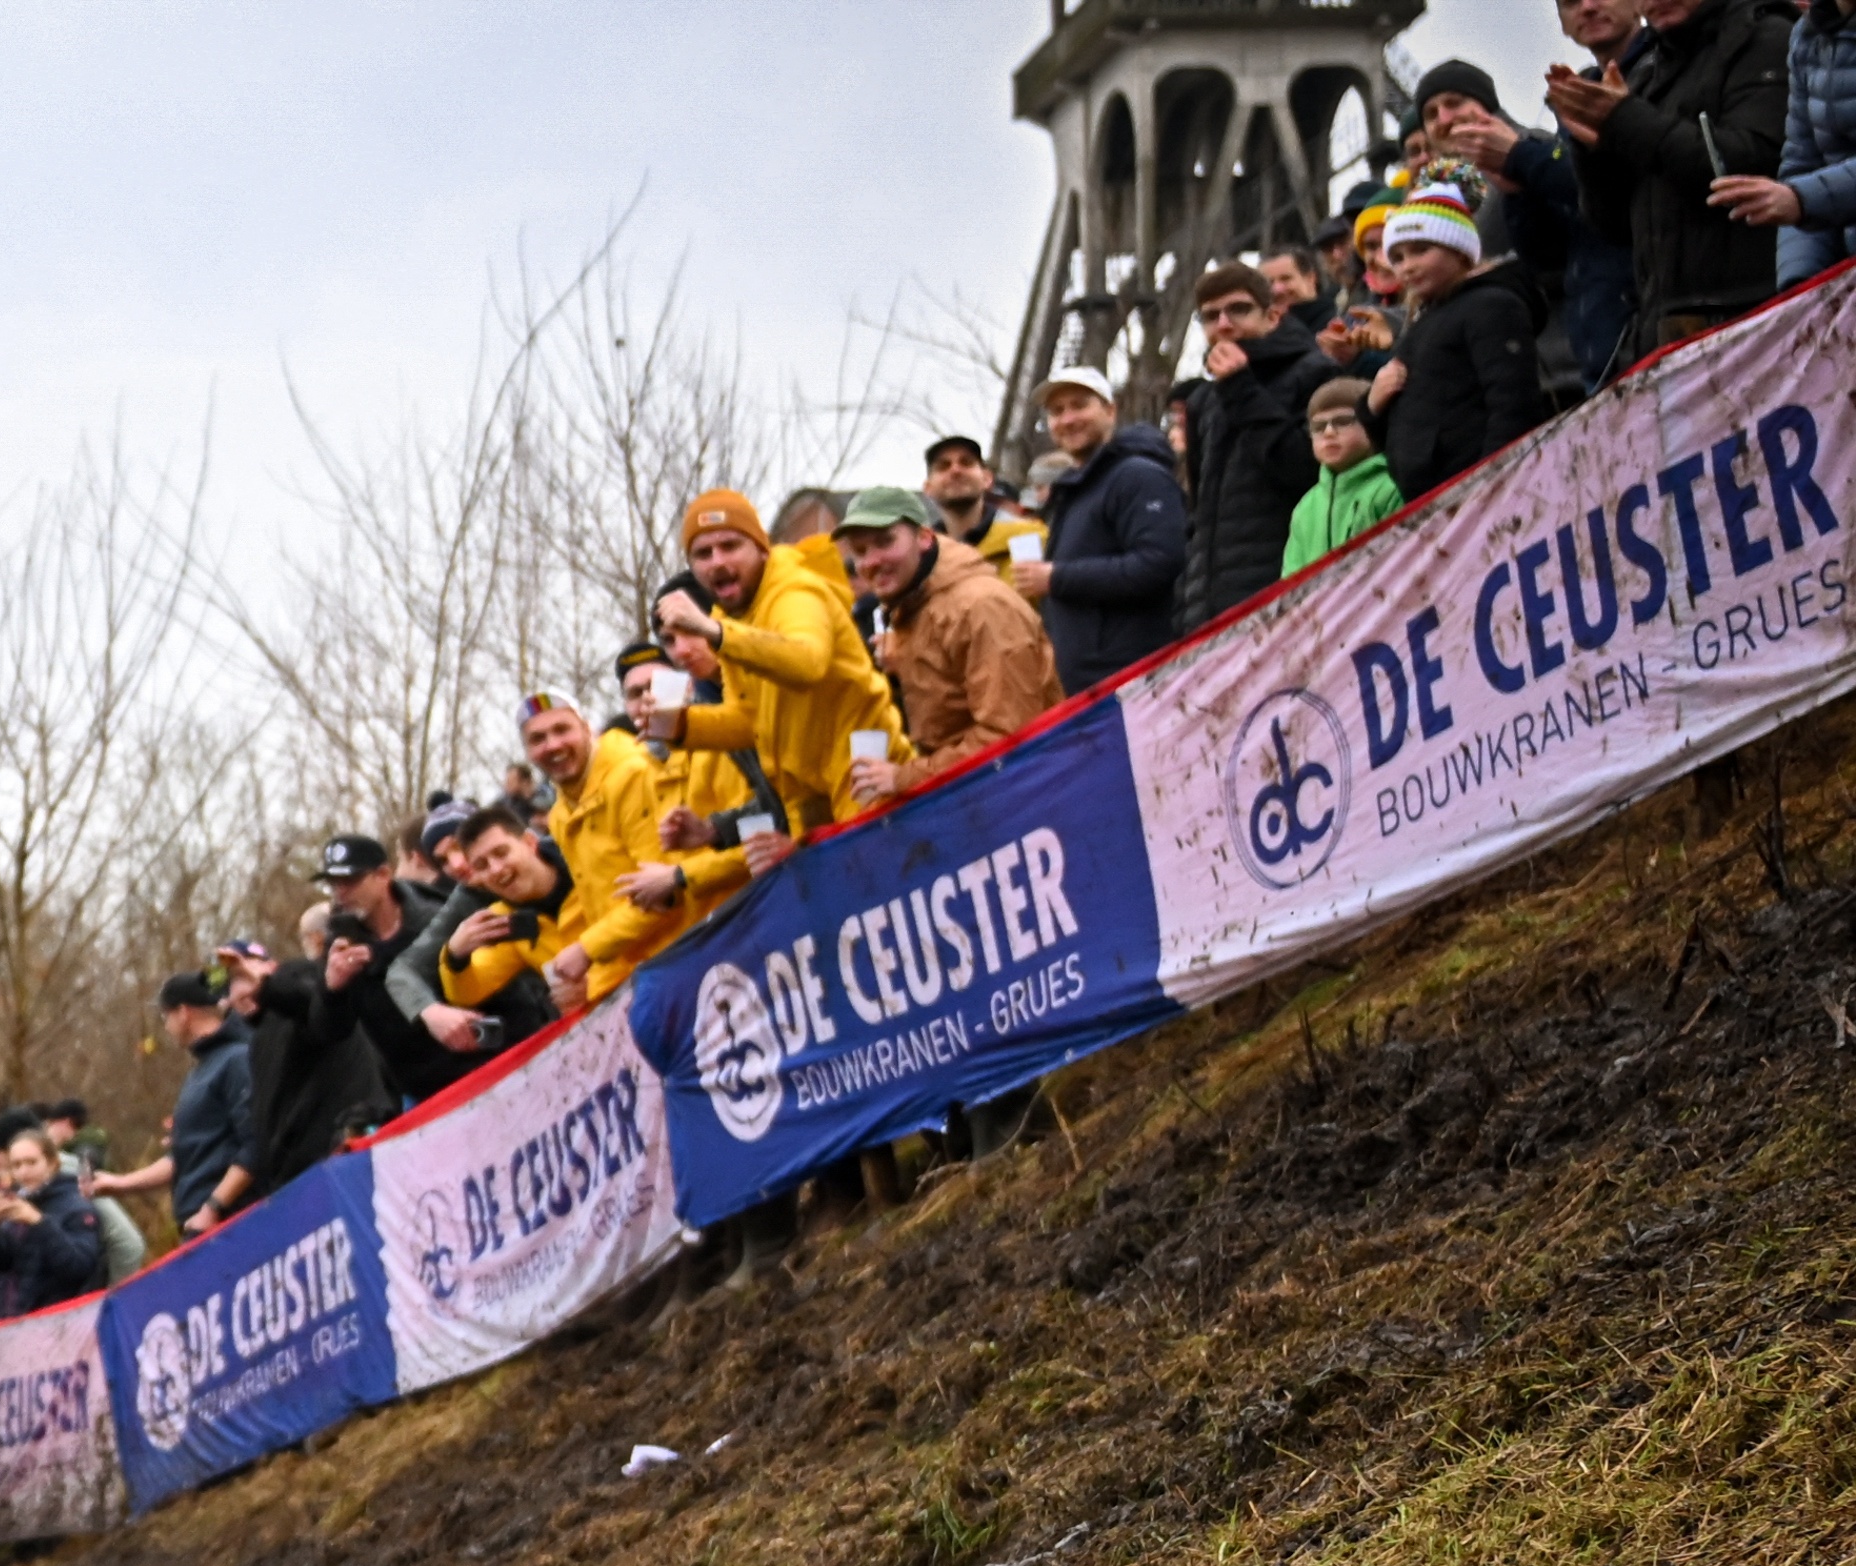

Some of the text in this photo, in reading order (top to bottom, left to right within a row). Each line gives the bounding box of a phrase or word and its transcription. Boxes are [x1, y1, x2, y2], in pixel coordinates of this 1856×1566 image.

[1351, 404, 1840, 769] DE CEUSTER
[1376, 652, 1650, 837] BOUWKRANEN
[1692, 559, 1846, 671] GRUES
[763, 827, 1079, 1056] DE CEUSTER
[791, 1012, 969, 1109] BOUWKRANEN
[990, 952, 1086, 1036] GRUES
[463, 1069, 650, 1264] DE CEUSTER
[188, 1217, 358, 1387] DE CEUSTER
